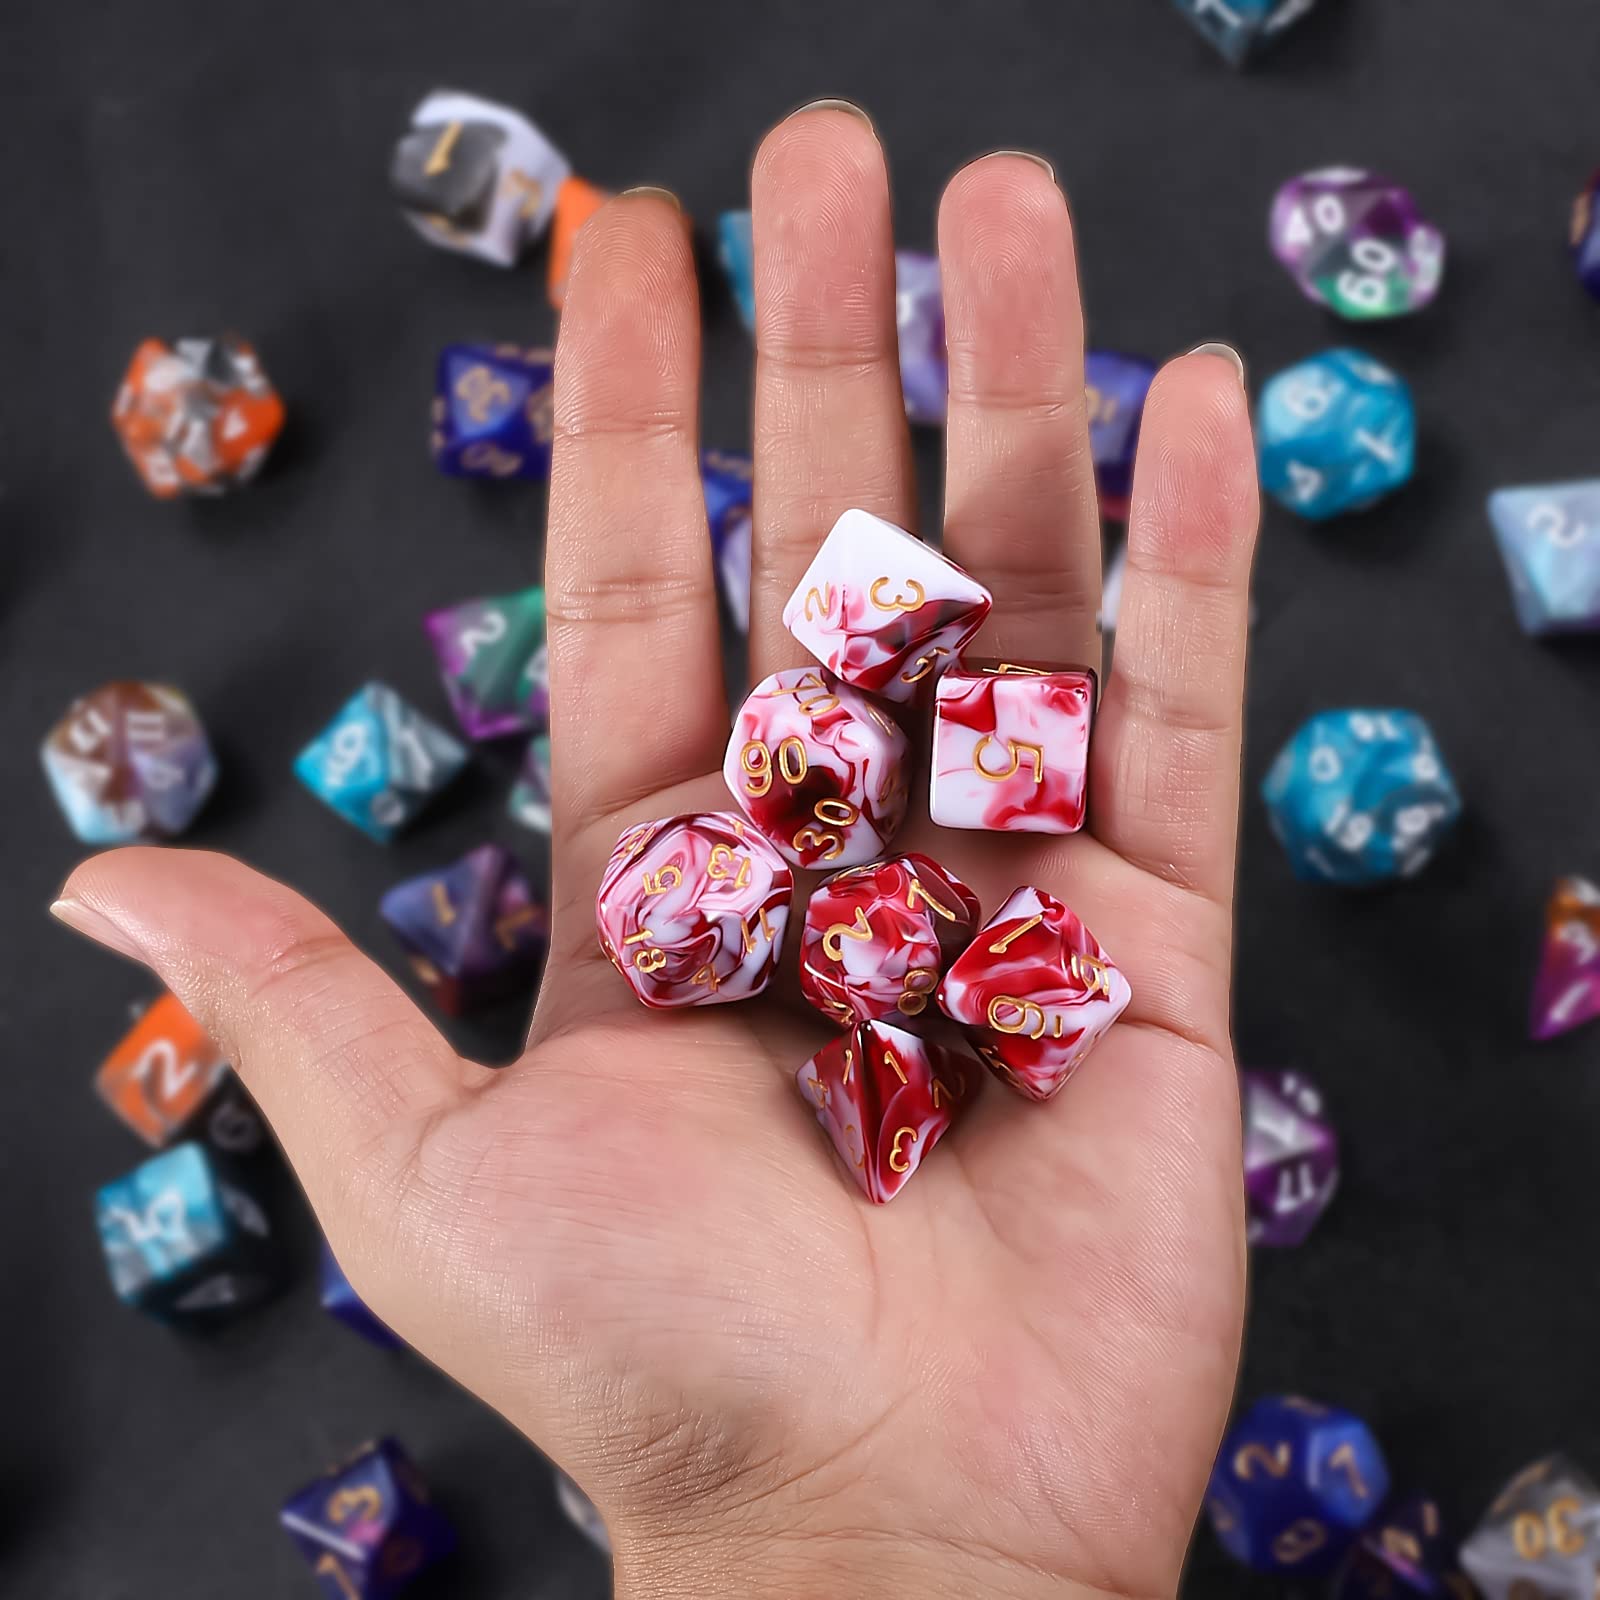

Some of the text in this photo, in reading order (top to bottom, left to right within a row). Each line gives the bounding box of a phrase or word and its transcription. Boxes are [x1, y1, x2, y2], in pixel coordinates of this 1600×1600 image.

[804, 581, 830, 622] 2
[870, 576, 925, 612] 3
[739, 736, 809, 799] 90
[972, 735, 1045, 785] 5
[792, 797, 861, 861] 30
[642, 864, 683, 897] 5
[707, 842, 752, 890] 13
[623, 926, 668, 974] 18
[740, 907, 777, 955] 11
[822, 906, 874, 962] 2
[988, 914, 1044, 954] 1
[897, 967, 940, 1017] 8
[130, 1036, 200, 1102] 2
[843, 1048, 854, 1086] 1
[884, 1050, 909, 1085] 1
[807, 1077, 829, 1109] 4
[889, 1126, 919, 1174] 3
